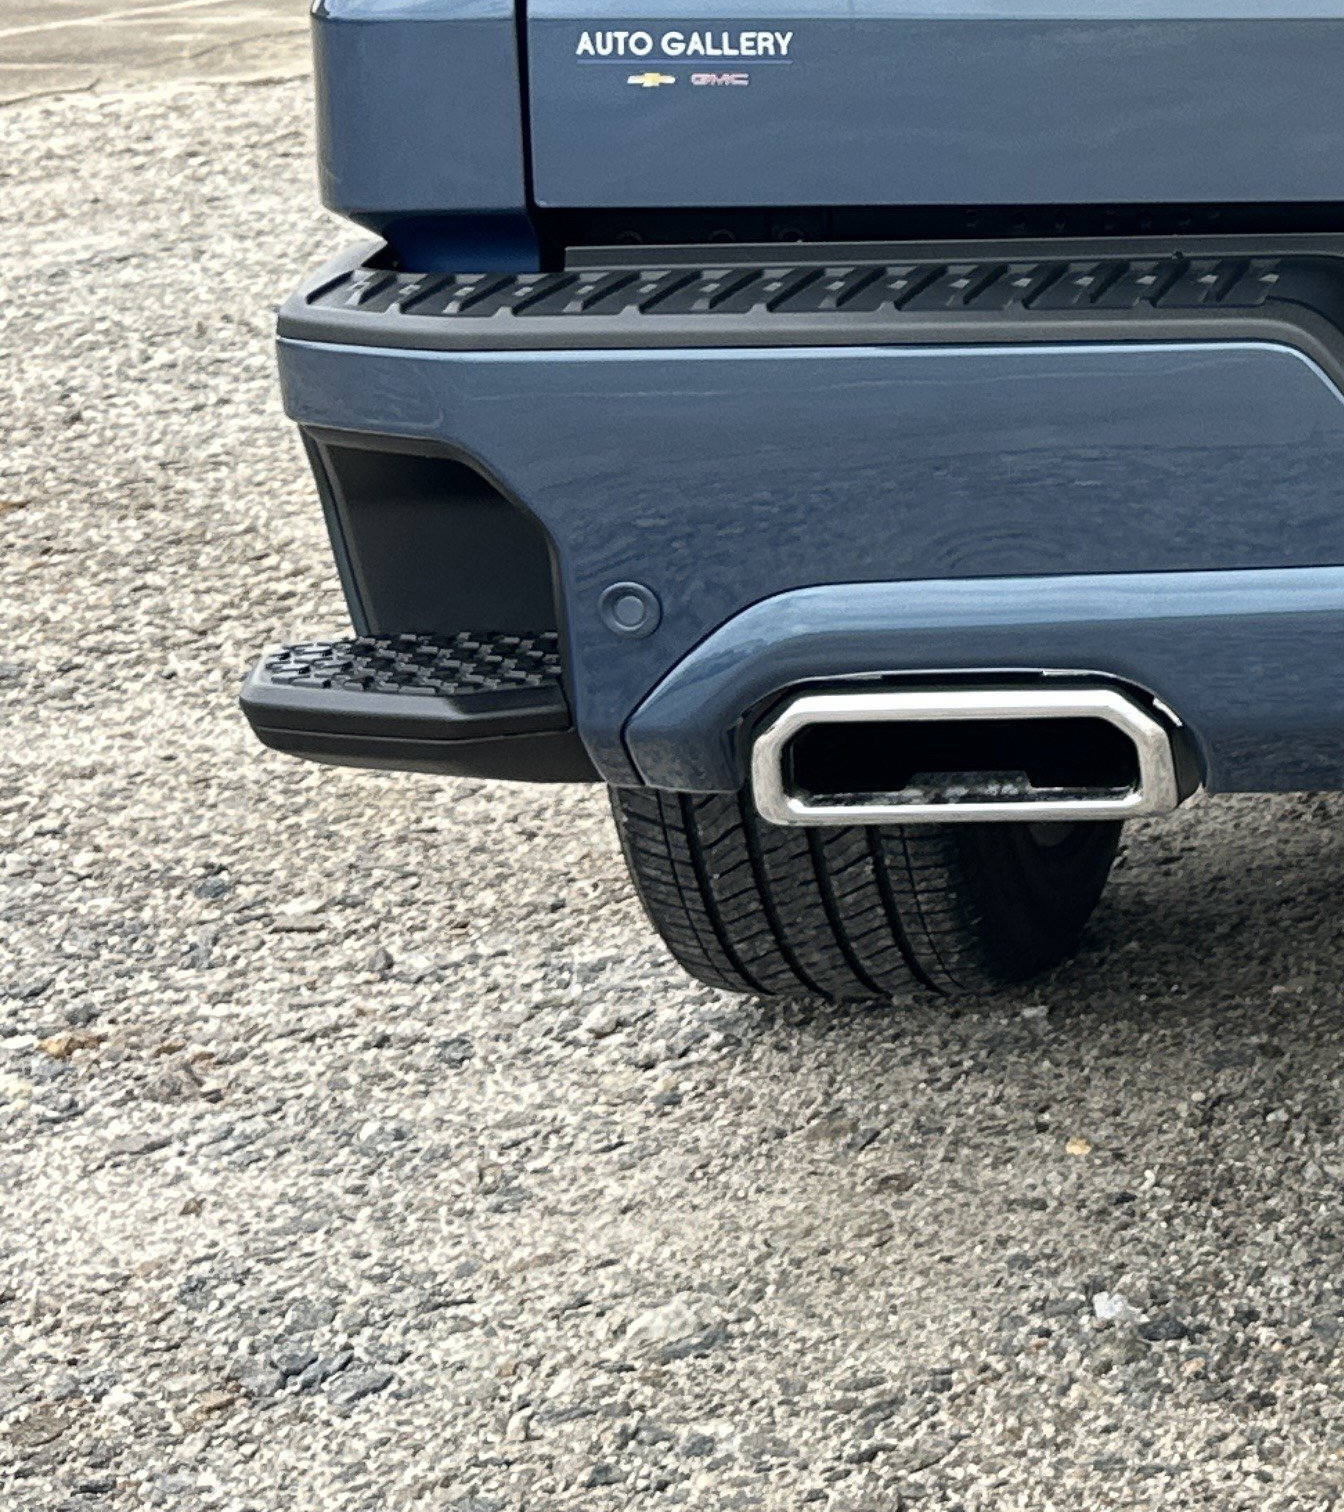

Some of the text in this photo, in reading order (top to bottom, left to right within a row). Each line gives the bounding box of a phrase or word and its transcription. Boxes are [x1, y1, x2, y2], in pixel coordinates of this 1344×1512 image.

[576, 31, 793, 56] AUTO GALLERY
[691, 73, 749, 86] GMC
